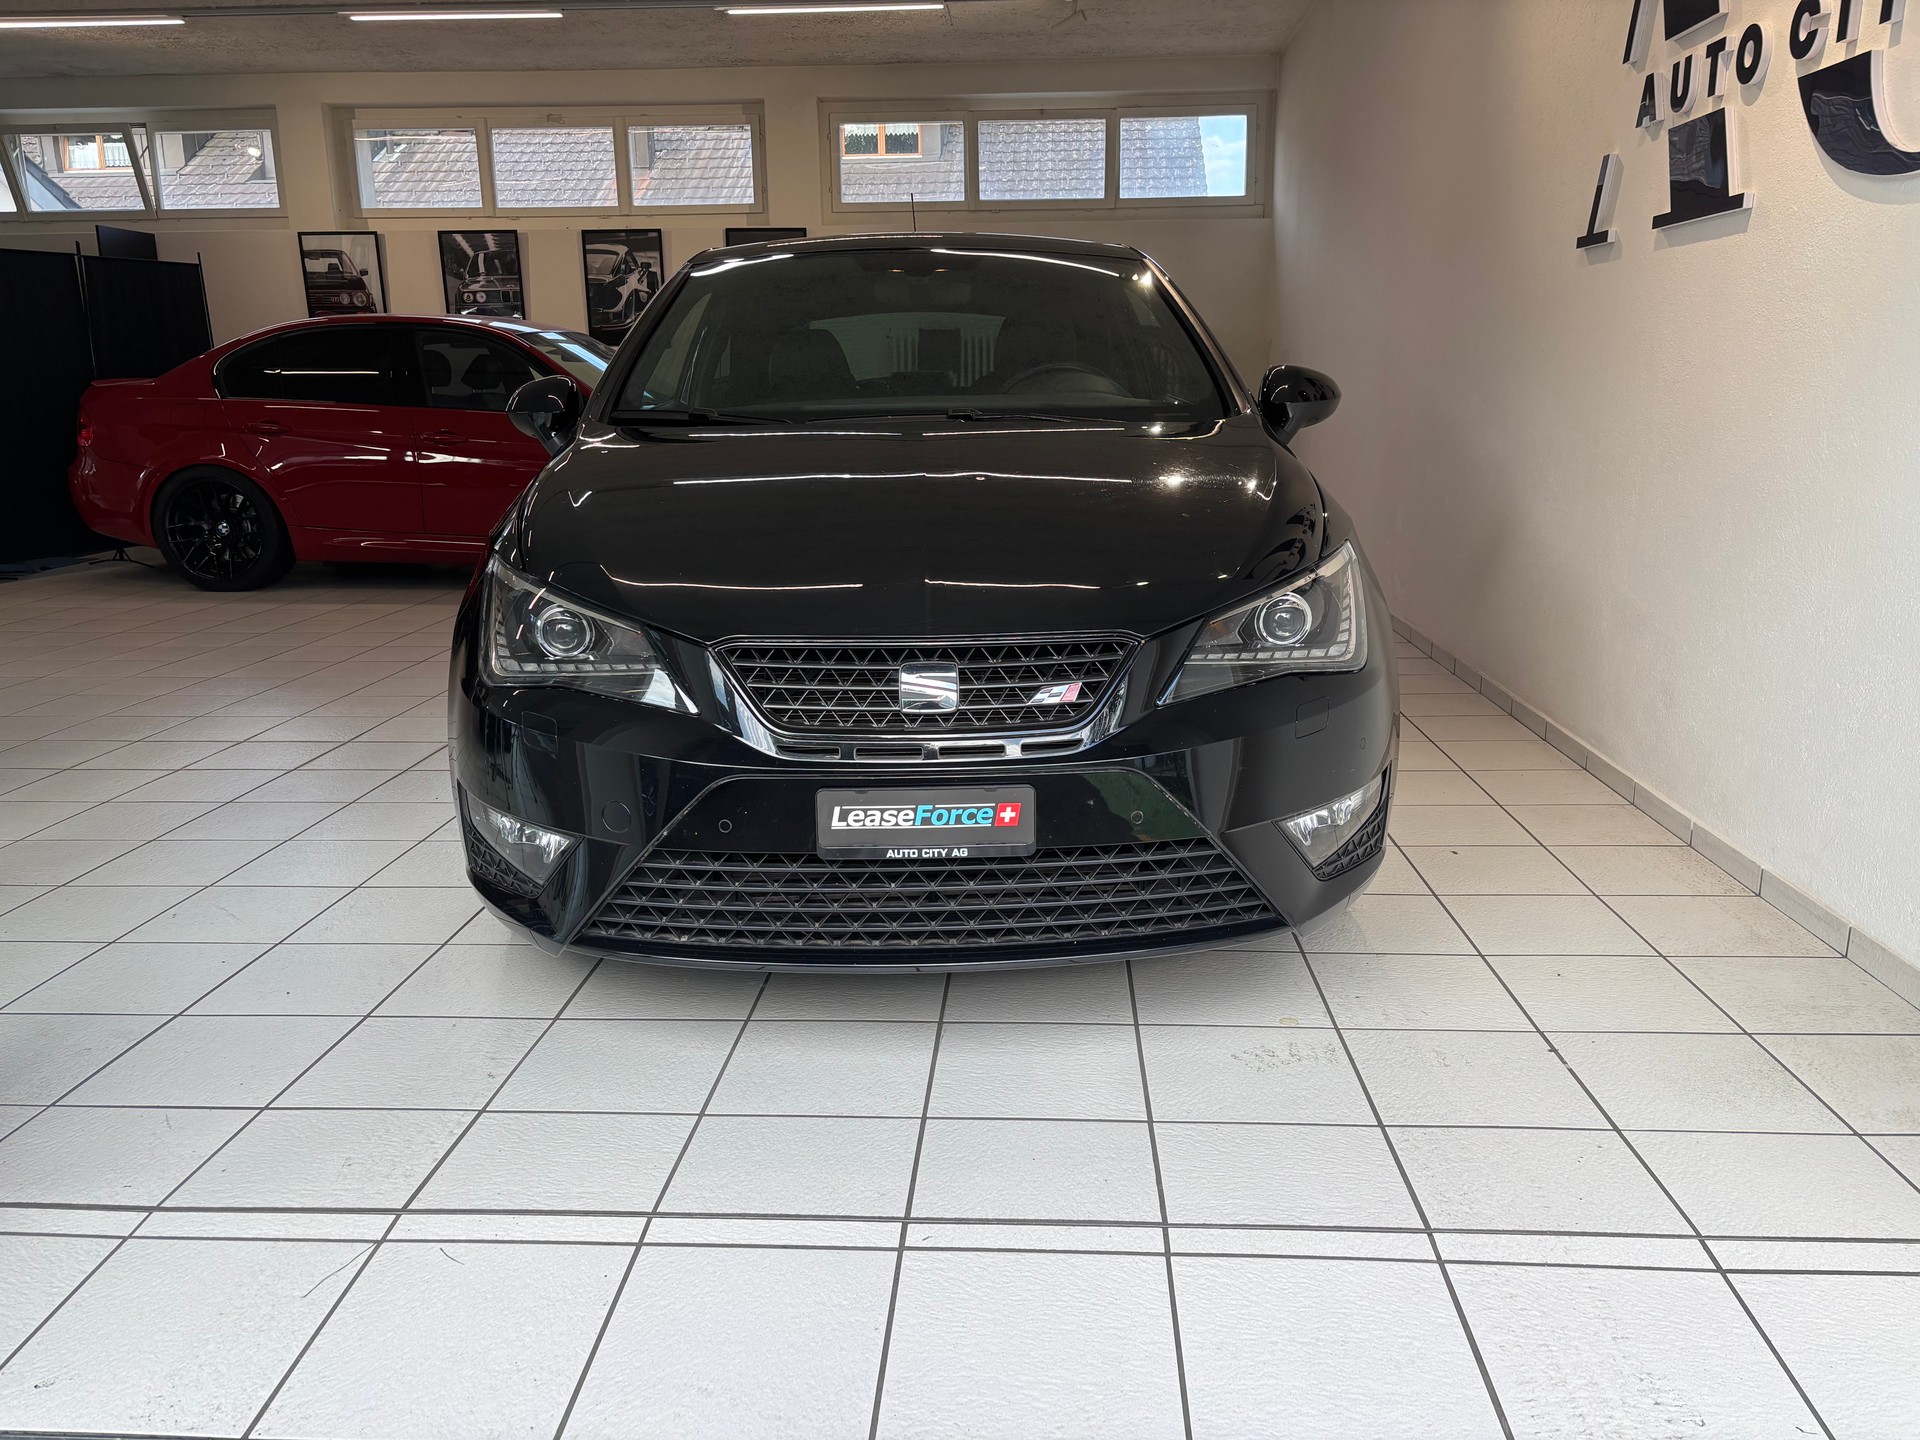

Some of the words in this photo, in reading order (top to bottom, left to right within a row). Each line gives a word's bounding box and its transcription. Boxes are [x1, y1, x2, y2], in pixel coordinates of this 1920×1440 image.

[1635, 22, 1768, 129] AUTO
[831, 804, 994, 827] LeaseForce
[886, 848, 919, 858] AUTO
[921, 848, 948, 858] CITY
[951, 847, 968, 857] AG
